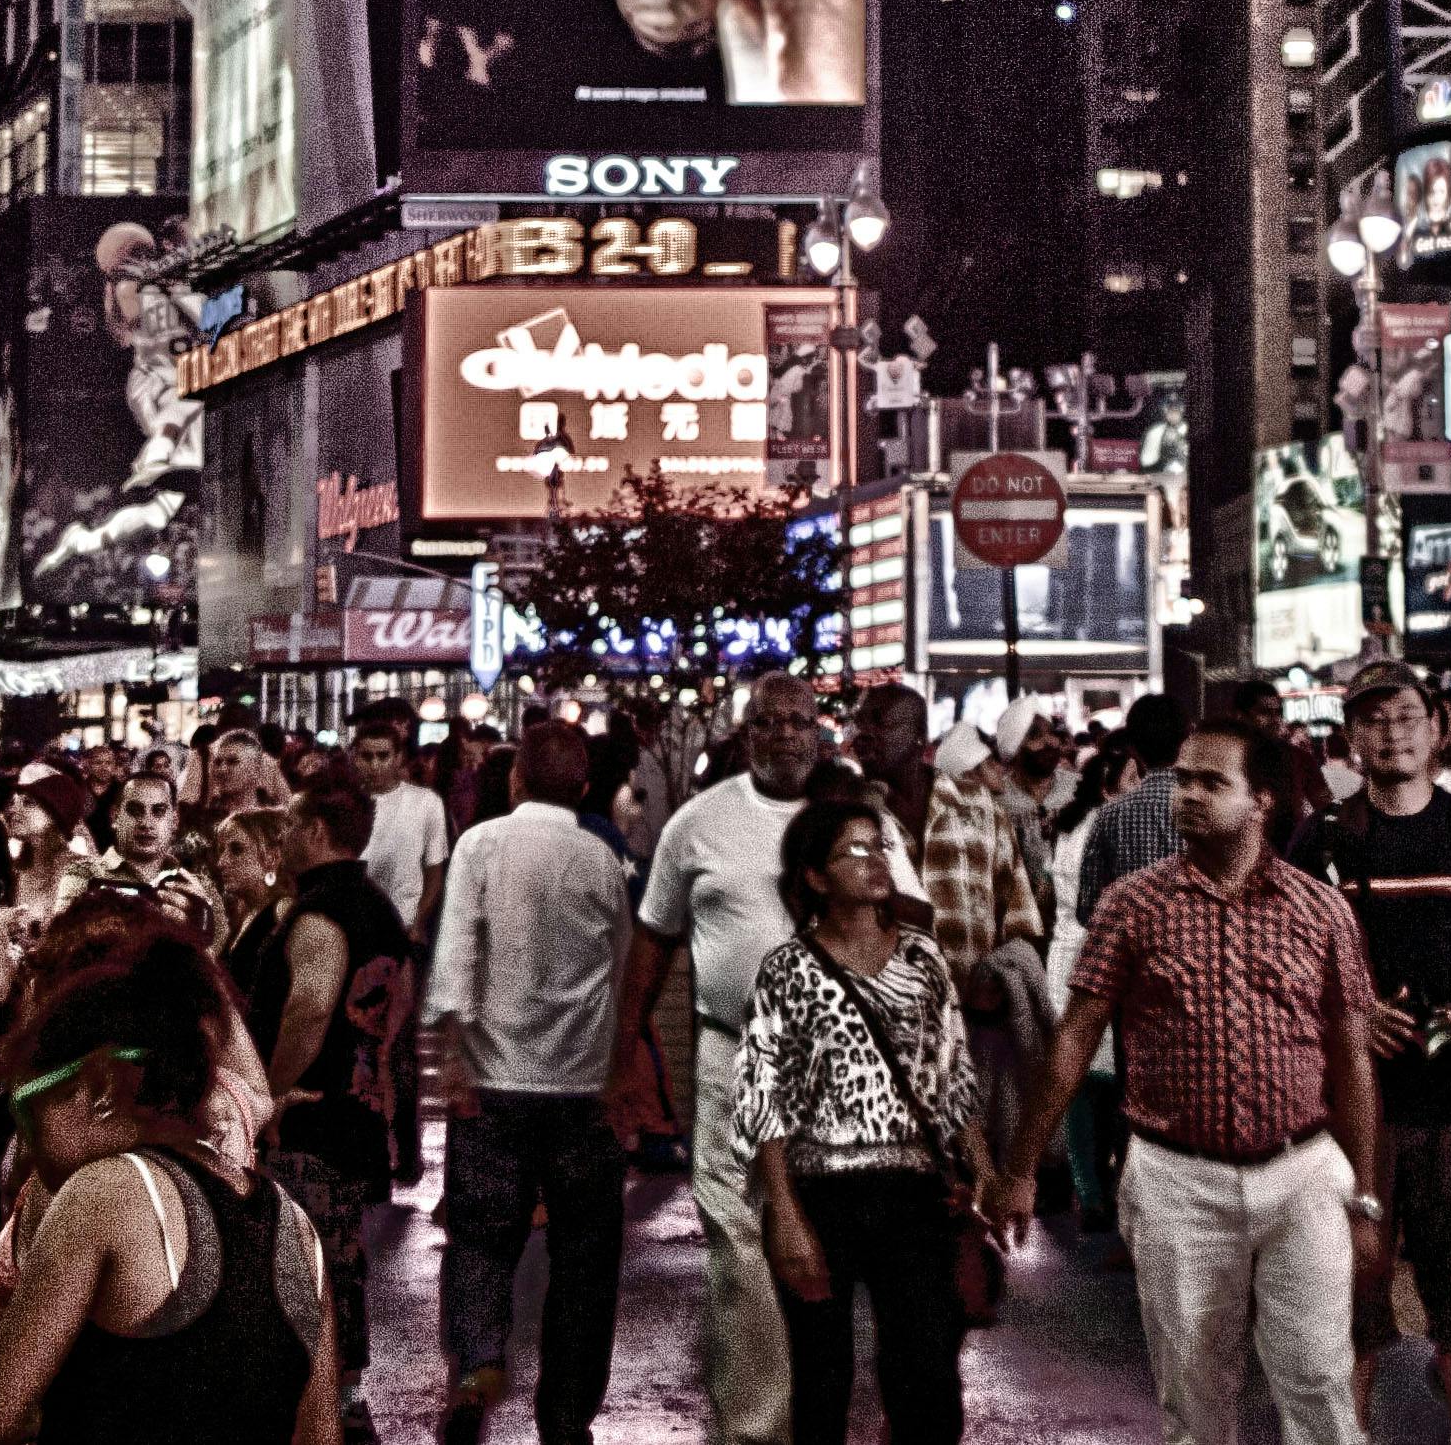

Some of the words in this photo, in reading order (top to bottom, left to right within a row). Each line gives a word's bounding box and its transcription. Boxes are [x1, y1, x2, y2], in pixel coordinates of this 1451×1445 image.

[545, 154, 741, 196] SONY
[972, 475, 1000, 494] DO
[1007, 474, 1046, 494] NOT
[977, 527, 1040, 546] ENTER
